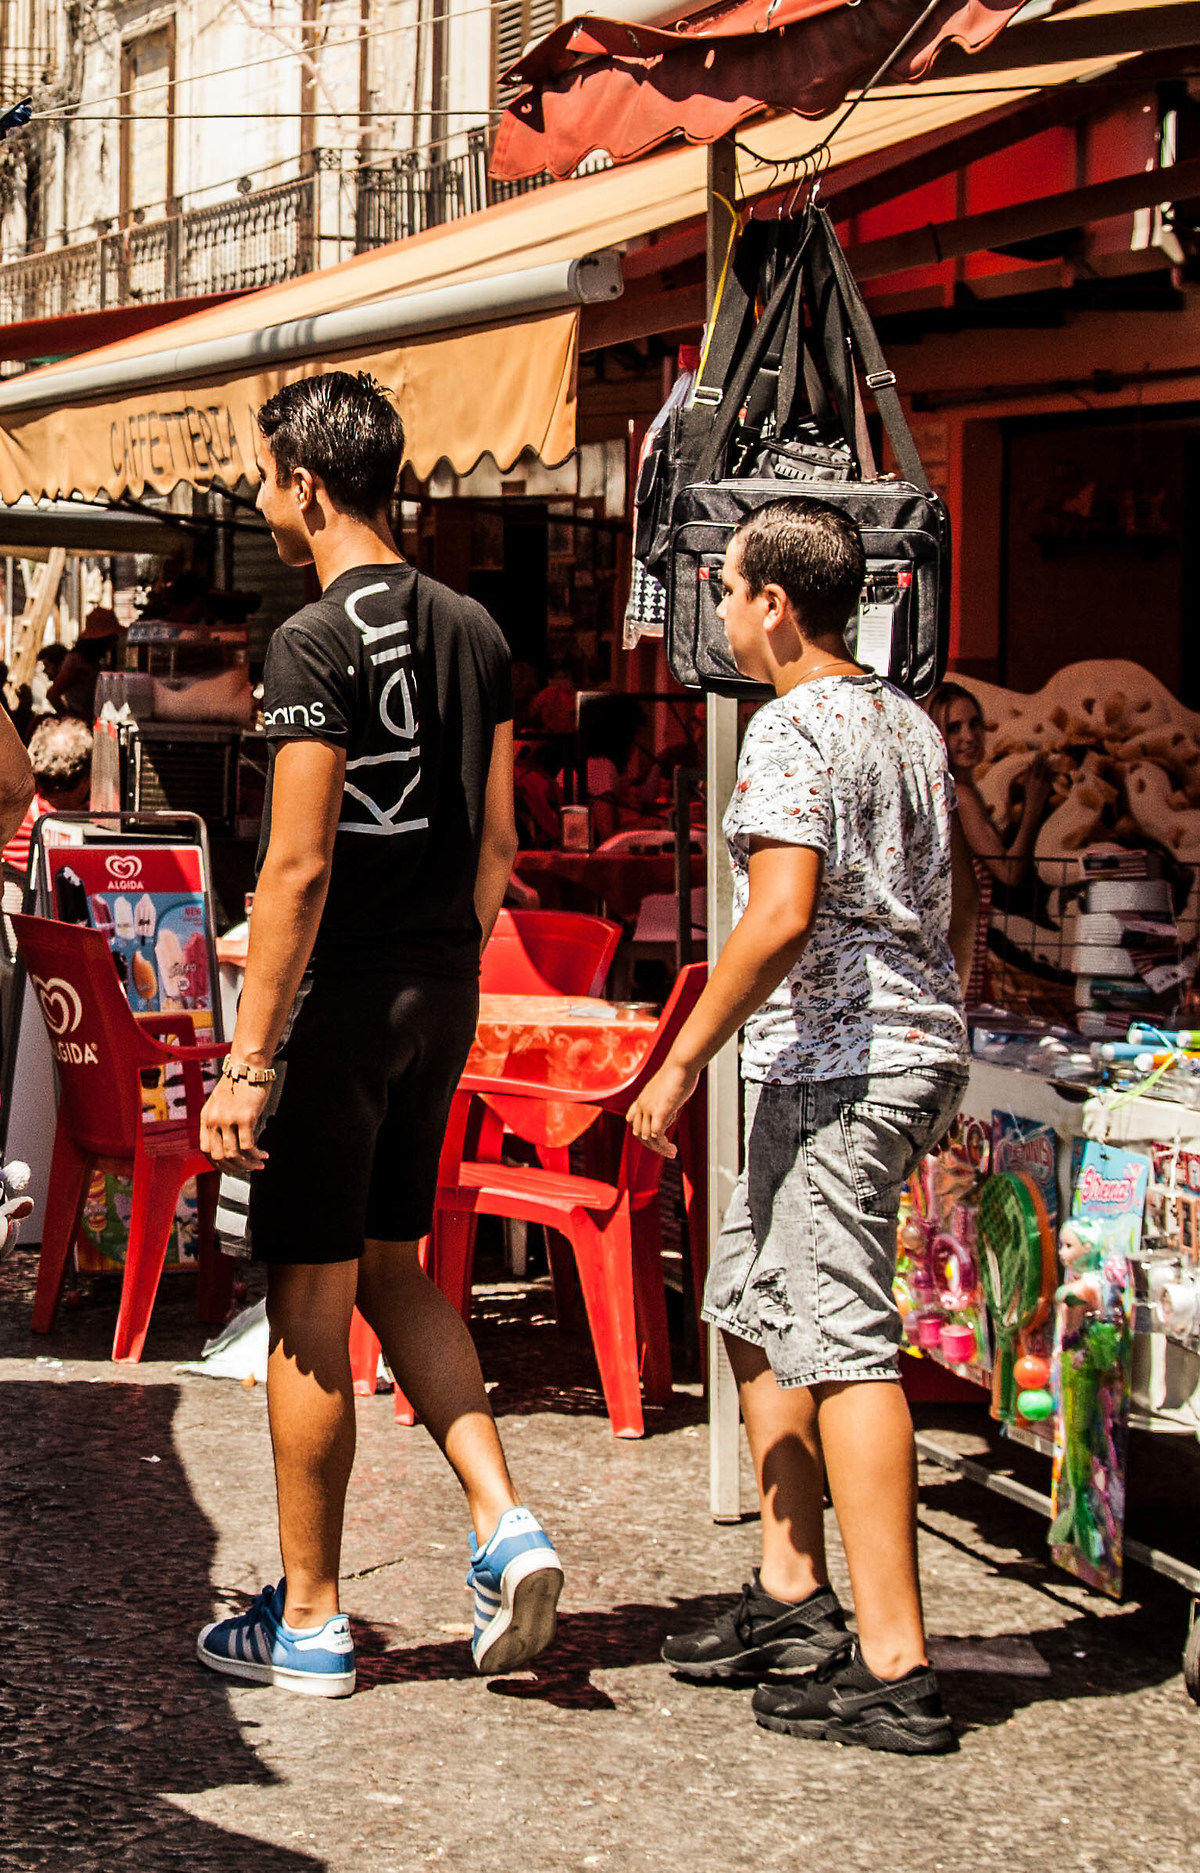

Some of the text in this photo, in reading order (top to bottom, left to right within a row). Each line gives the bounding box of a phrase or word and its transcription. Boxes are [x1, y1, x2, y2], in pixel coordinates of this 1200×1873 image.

[110, 404, 243, 477] CAFFETTERIA
[263, 701, 326, 727] eans
[337, 581, 429, 836] Klein
[107, 880, 144, 890] ALGIDA
[57, 1041, 99, 1065] GIDA
